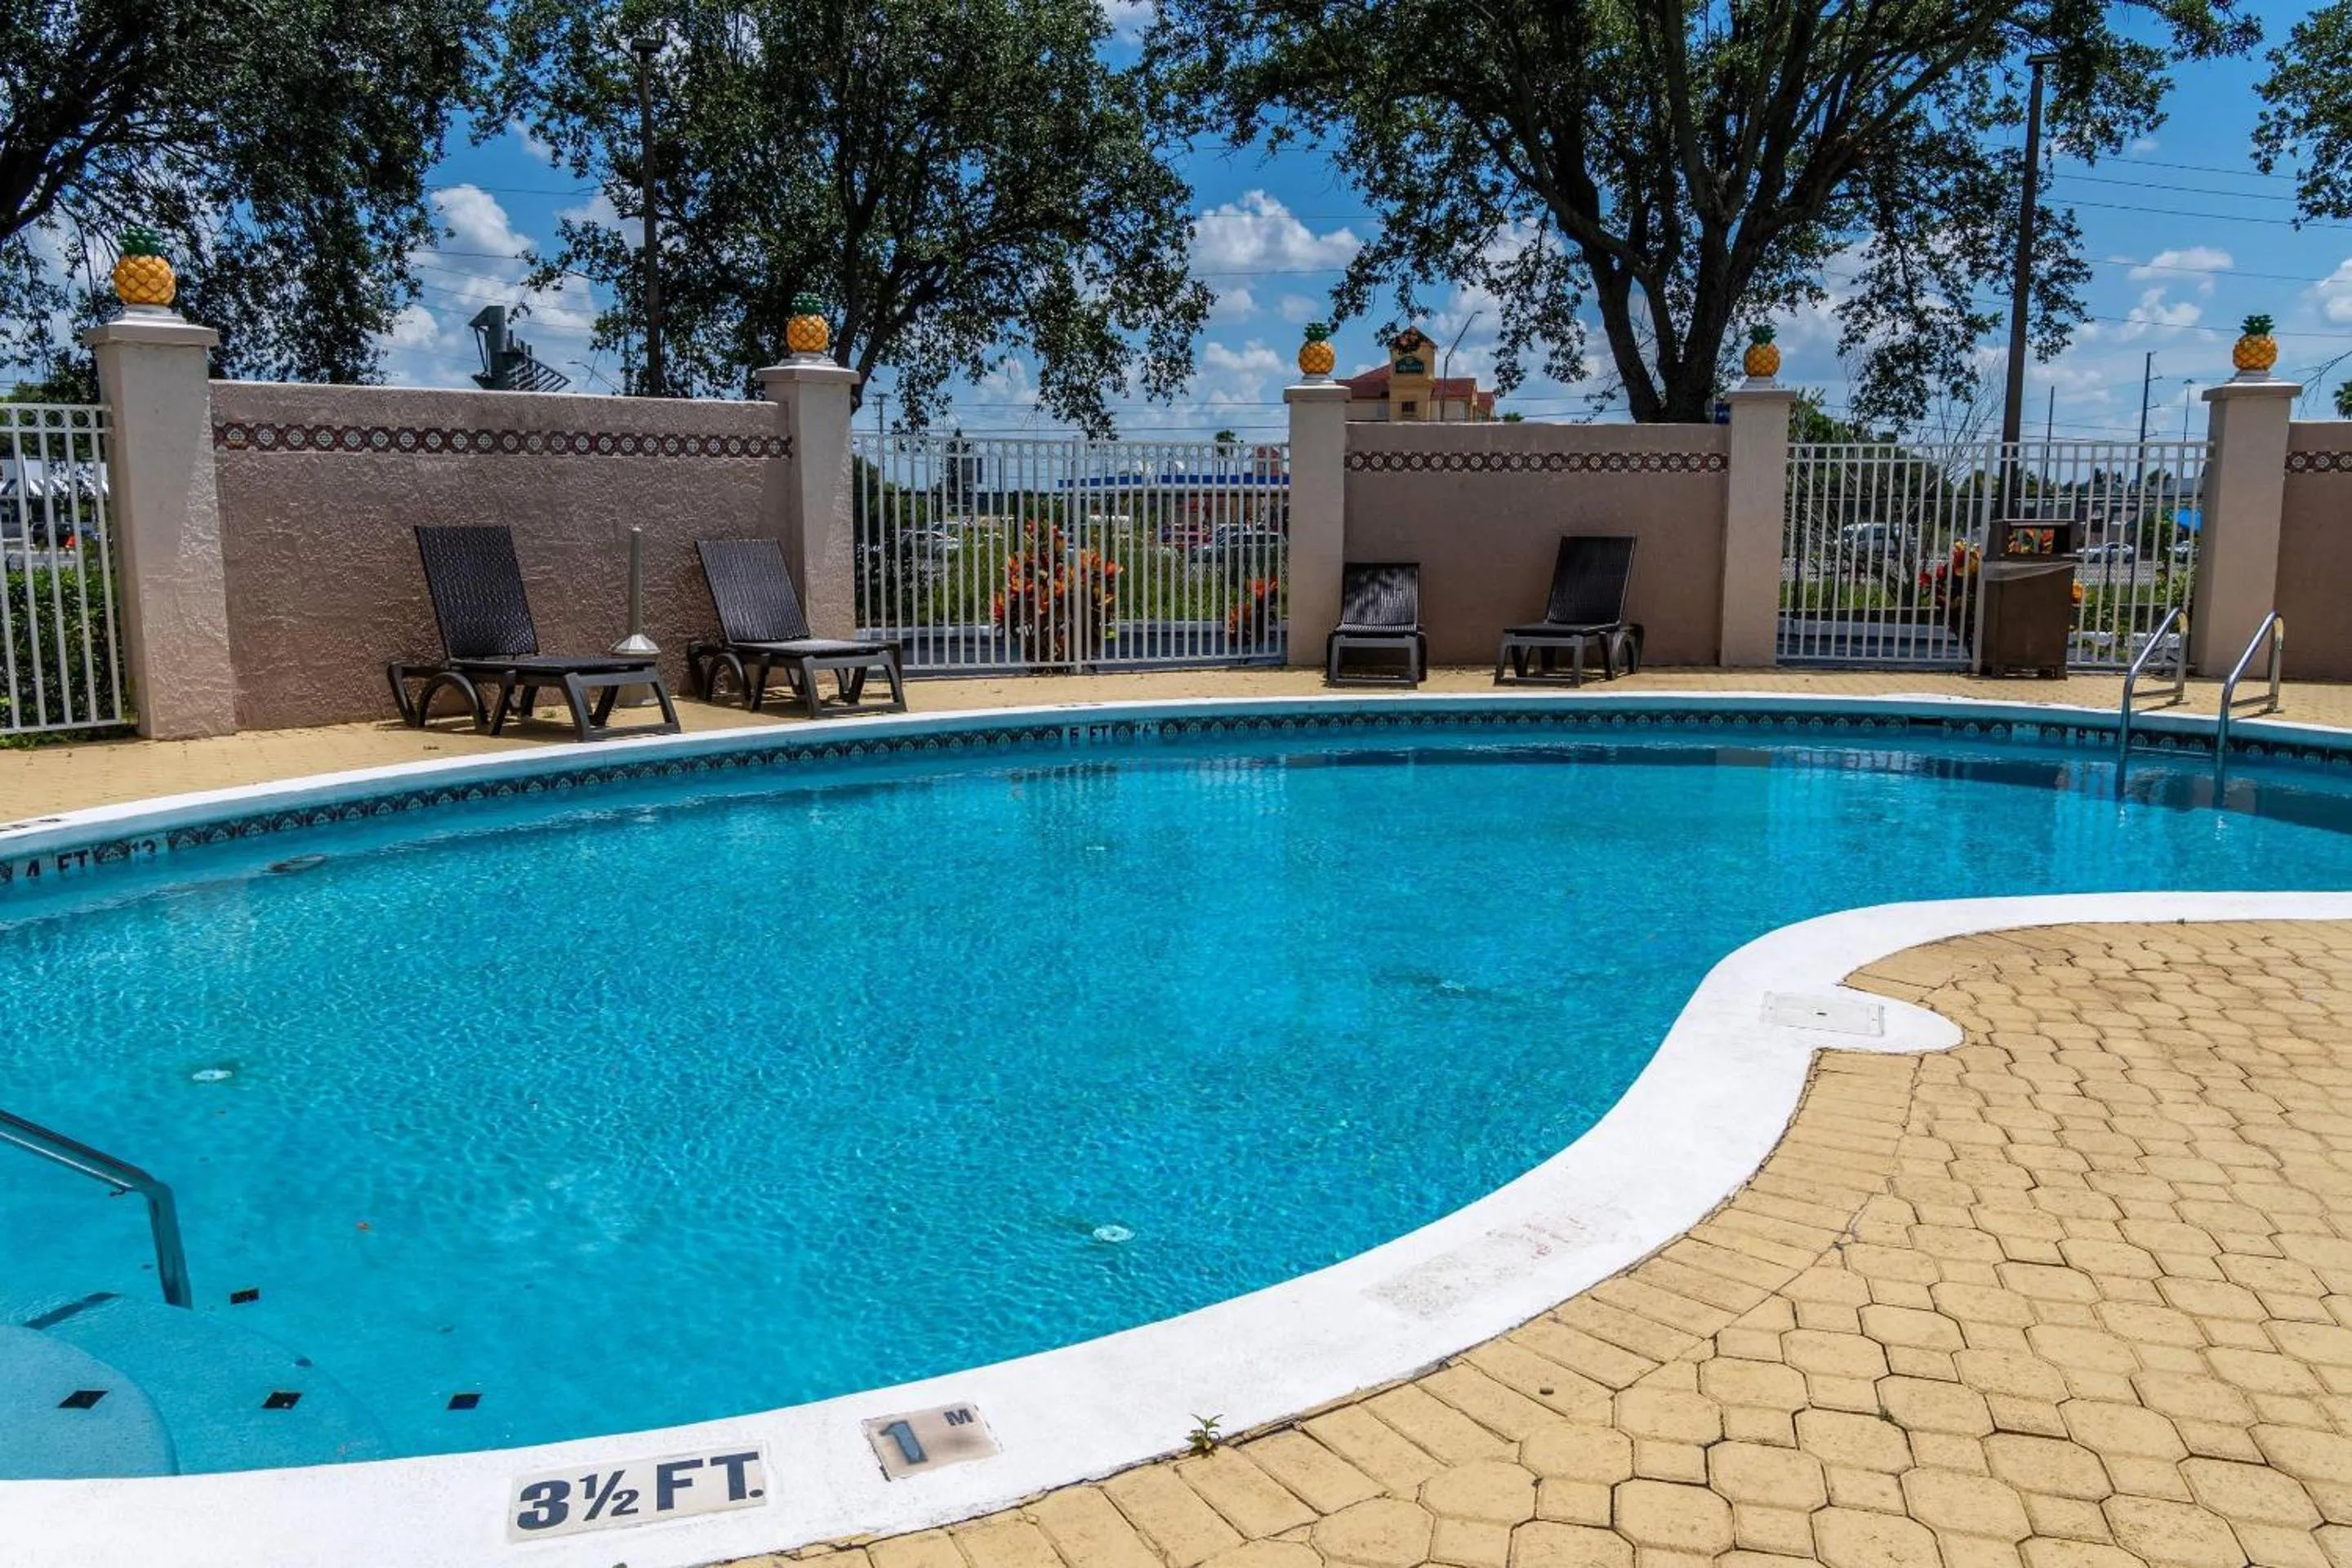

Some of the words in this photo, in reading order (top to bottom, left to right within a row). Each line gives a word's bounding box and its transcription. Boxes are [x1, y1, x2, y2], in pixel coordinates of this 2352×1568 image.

[878, 1419, 929, 1465] 1
[943, 1407, 974, 1427] M
[656, 1450, 764, 1511] FT.
